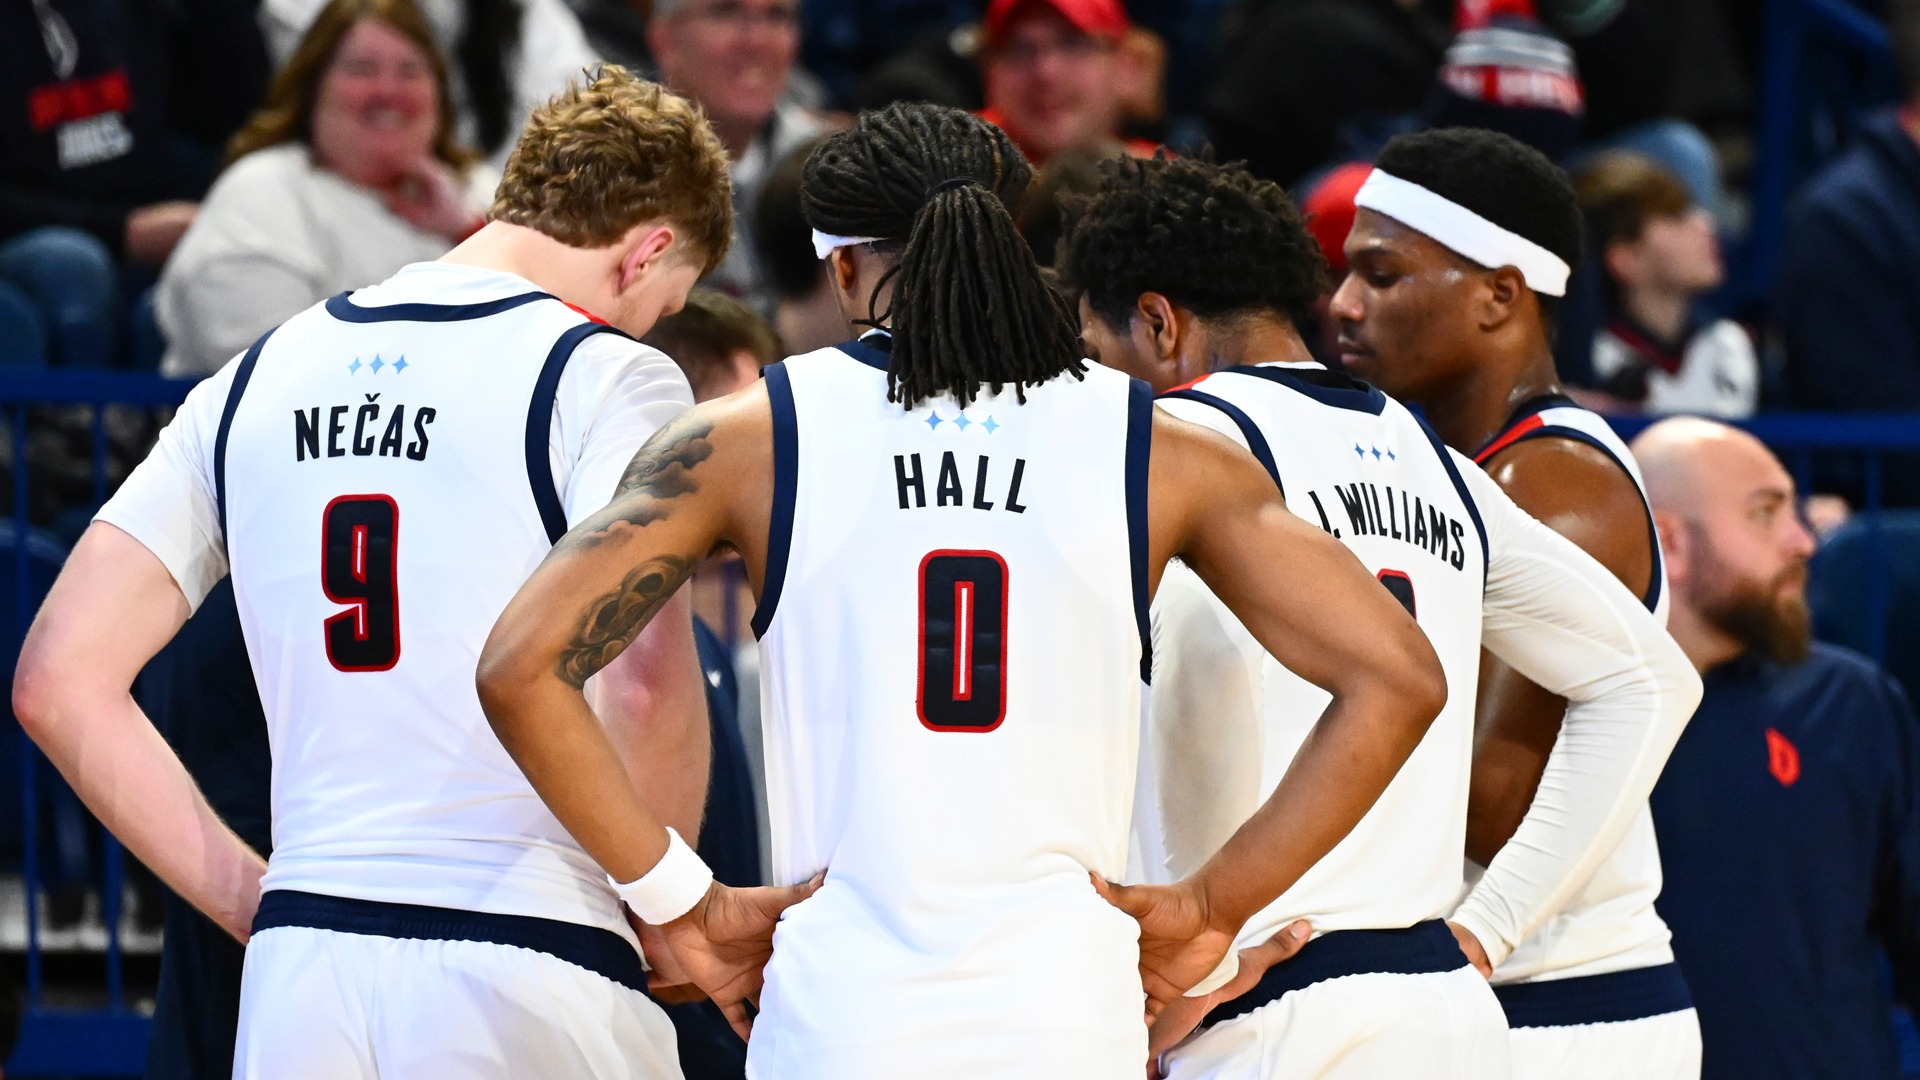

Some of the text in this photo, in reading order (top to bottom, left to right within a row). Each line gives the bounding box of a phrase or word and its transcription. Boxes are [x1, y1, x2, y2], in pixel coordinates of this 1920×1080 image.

[294, 393, 437, 462] NEČAS
[894, 450, 1027, 514] HALL
[1334, 482, 1465, 571] WILLIAMS
[321, 492, 401, 673] 9
[917, 548, 1010, 734] 0
